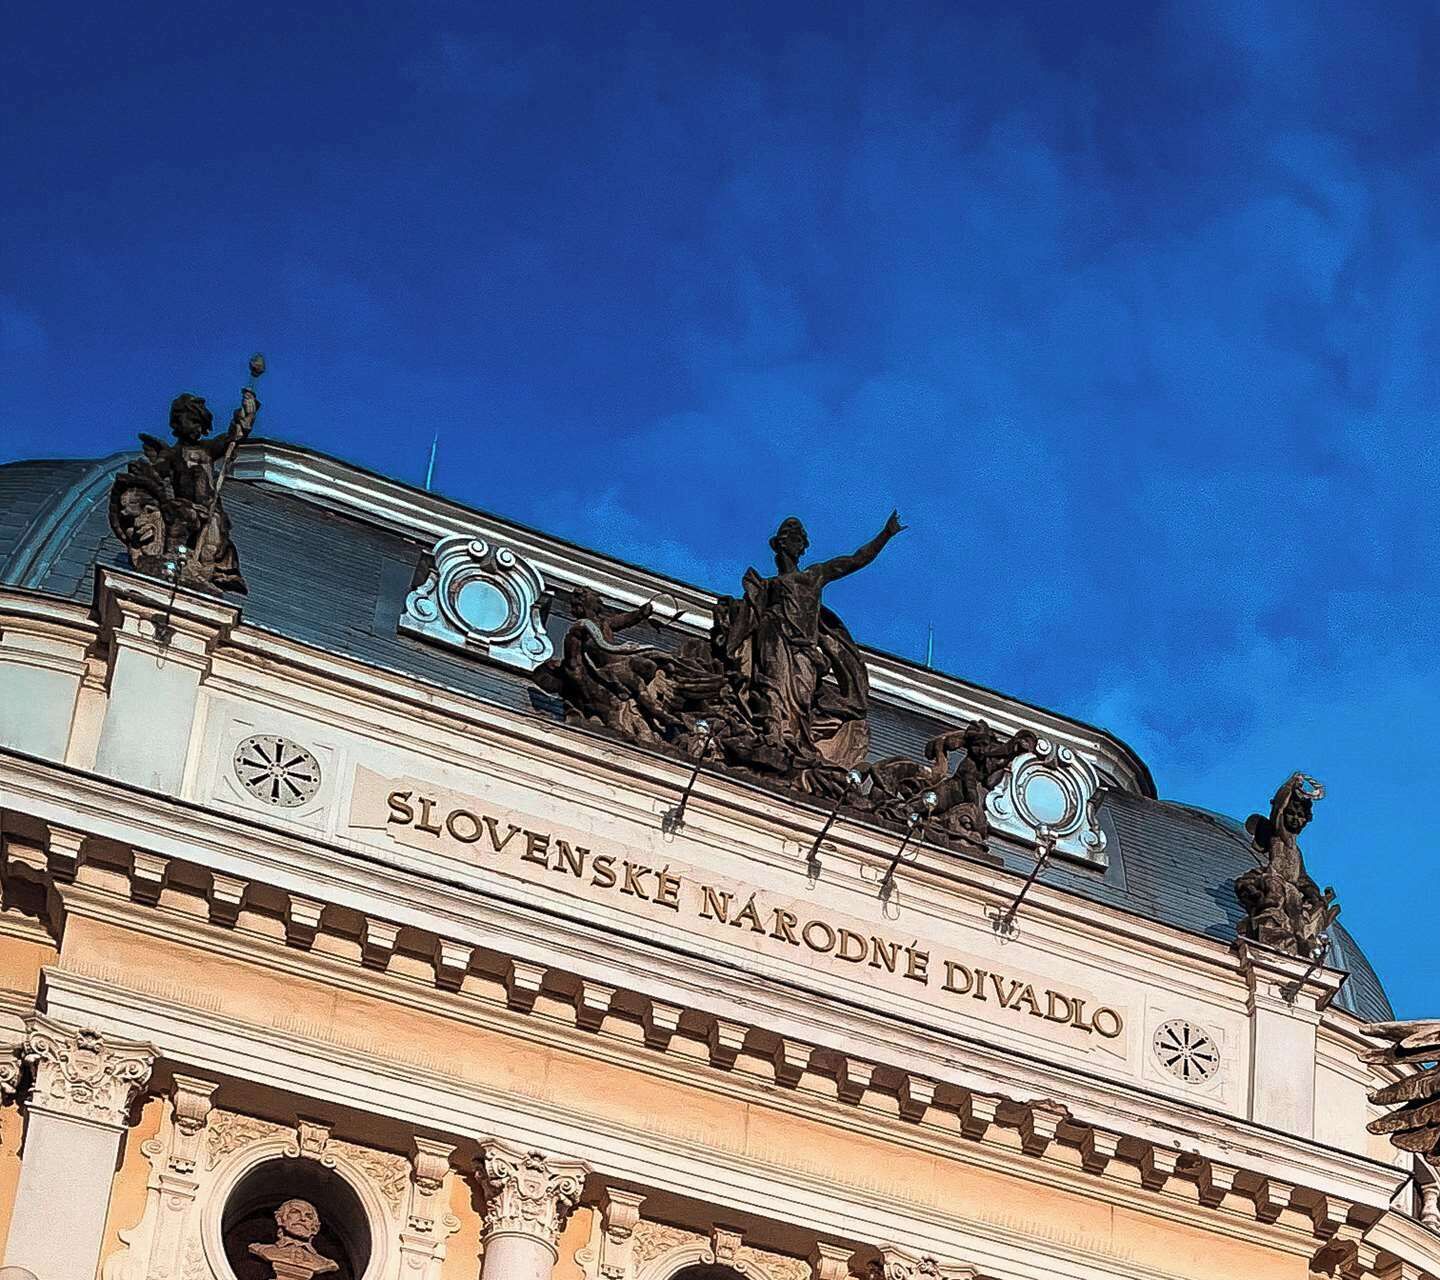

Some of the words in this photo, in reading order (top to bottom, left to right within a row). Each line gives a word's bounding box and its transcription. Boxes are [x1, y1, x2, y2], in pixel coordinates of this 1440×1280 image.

[387, 790, 683, 912] SLOVENSKÉ
[698, 885, 930, 986] NÁRODNÉ
[940, 960, 1124, 1039] DIVADLO
